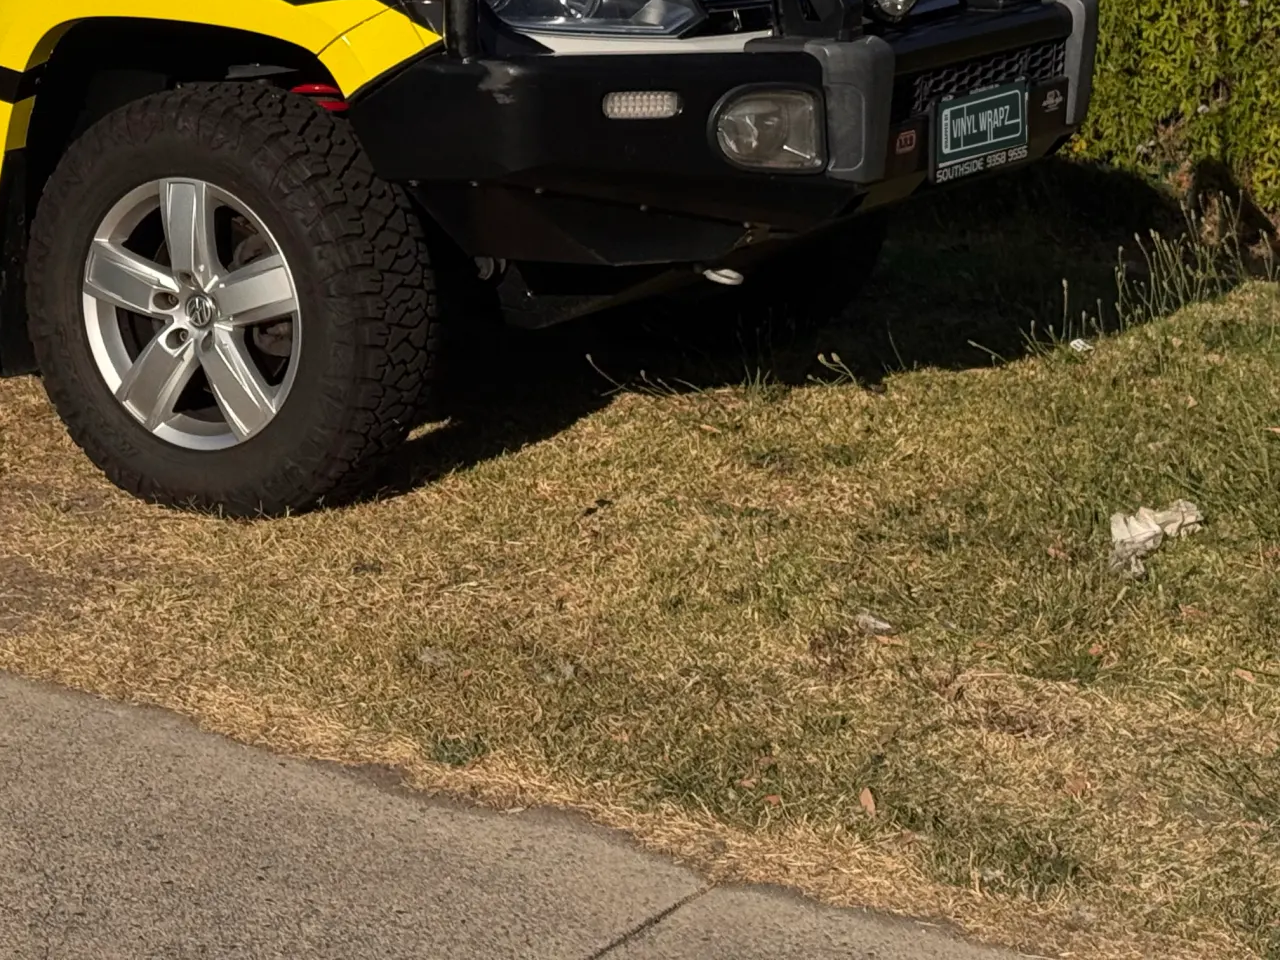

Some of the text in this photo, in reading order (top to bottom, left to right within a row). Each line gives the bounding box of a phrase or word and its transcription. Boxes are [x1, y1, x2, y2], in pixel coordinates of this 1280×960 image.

[951, 104, 1011, 139] VINYL WRAPZ
[936, 157, 984, 184] SOUTHSIDE
